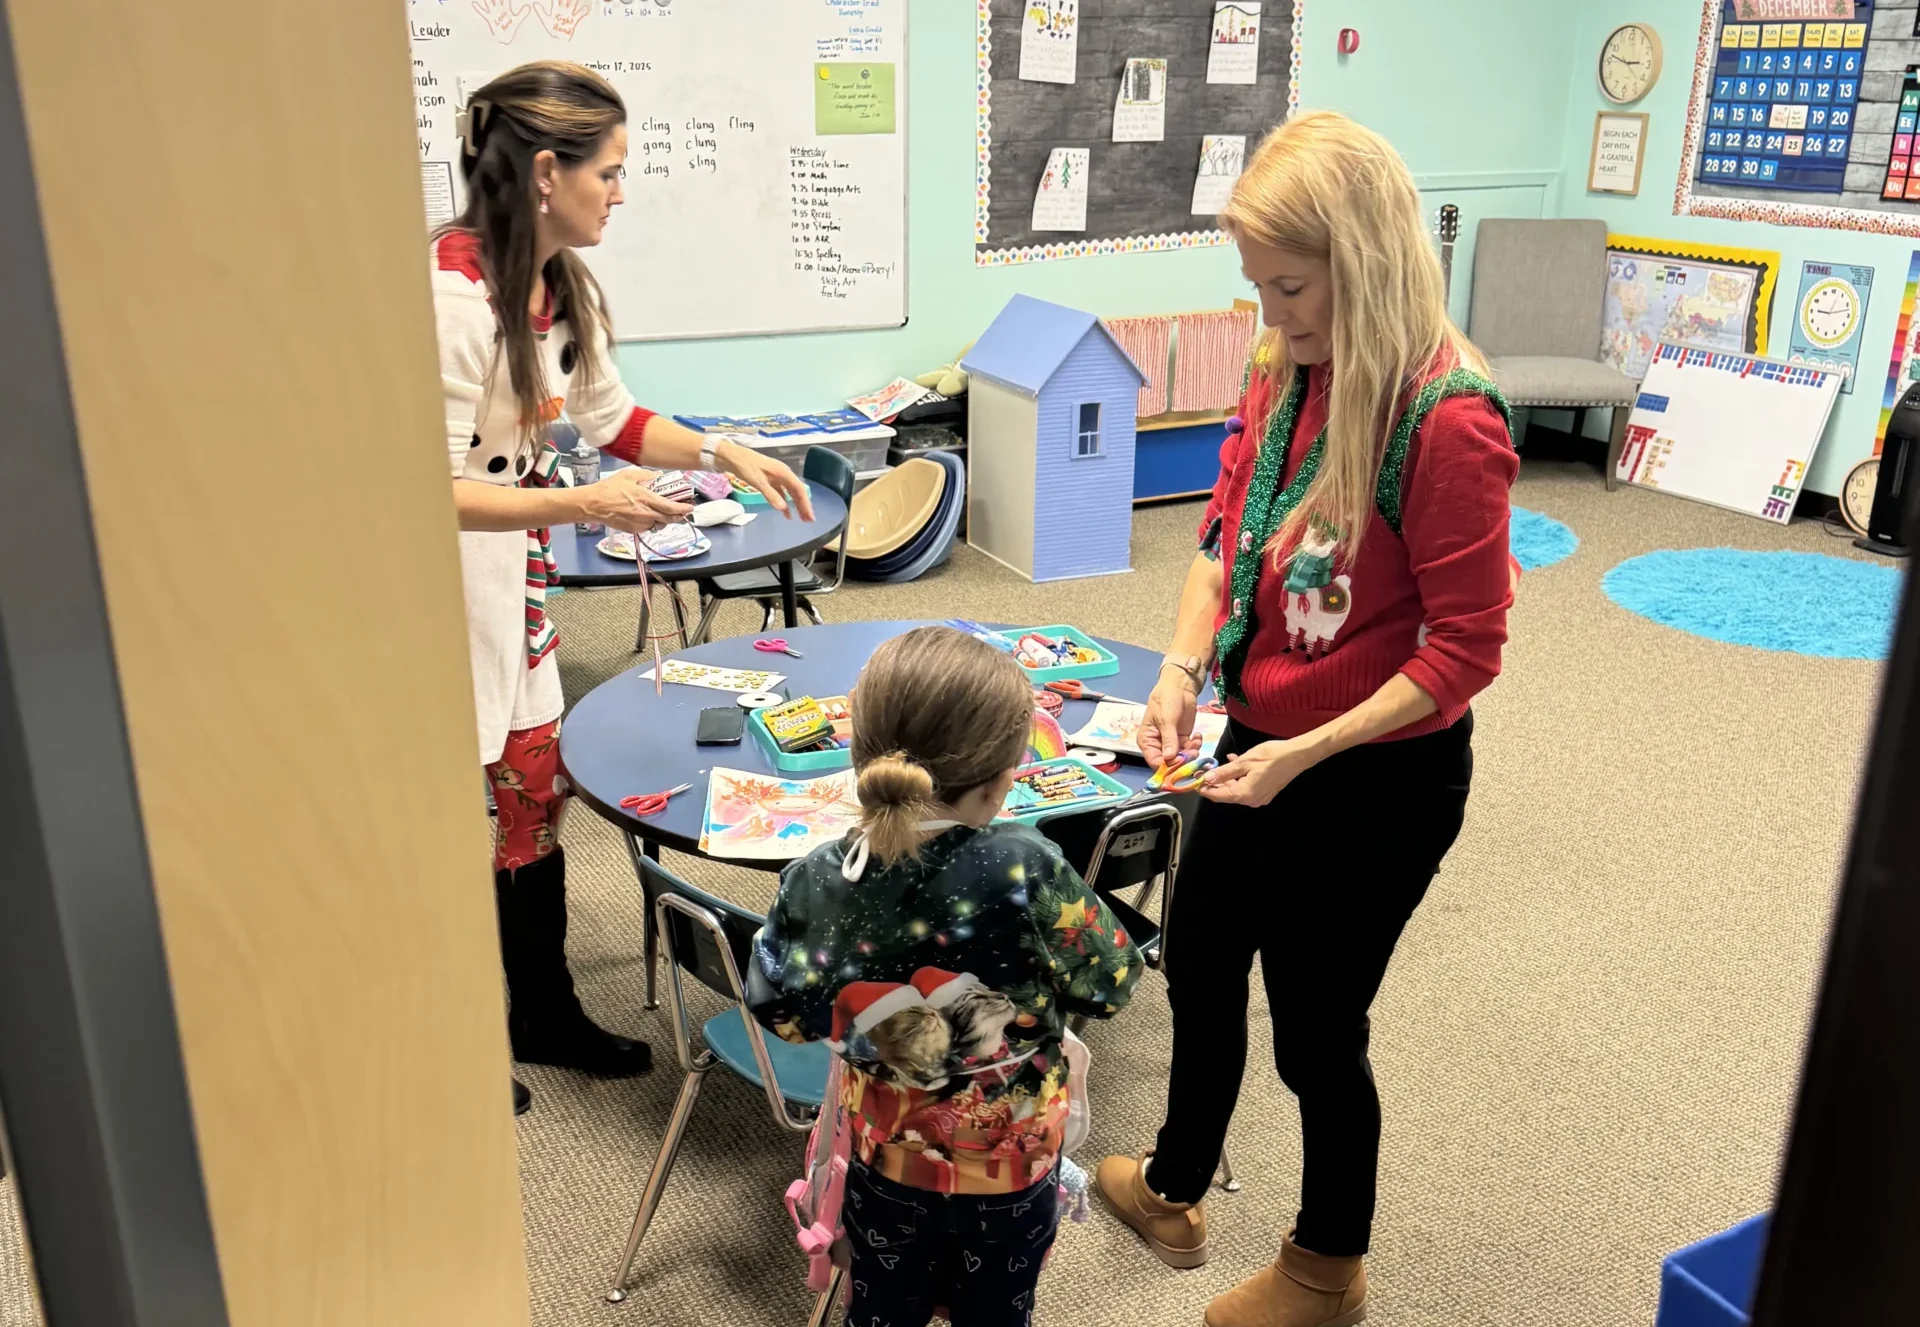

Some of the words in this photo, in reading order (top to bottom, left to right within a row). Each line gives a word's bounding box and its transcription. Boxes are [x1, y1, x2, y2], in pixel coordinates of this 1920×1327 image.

[1760, 0, 1828, 17] DECEMBER
[411, 20, 450, 38] Leader
[629, 62, 652, 71] 2025
[1745, 56, 1750, 69] 1
[1762, 56, 1771, 70] 2
[1782, 56, 1791, 69] 3
[1803, 55, 1812, 70] 4
[1824, 55, 1833, 69] 5
[1845, 57, 1854, 71] 6
[1720, 81, 1729, 95] 7
[1738, 82, 1747, 95] 8
[1758, 82, 1766, 96] 9
[1776, 82, 1789, 96] 10
[1799, 83, 1808, 97] 11
[1817, 83, 1830, 97] 12
[1840, 84, 1852, 98] 13
[1713, 107, 1724, 120] 14
[1732, 108, 1744, 121] 15
[1751, 108, 1763, 122] 16
[1812, 110, 1825, 124] 19
[1832, 111, 1848, 125] 20
[642, 117, 671, 135] cling
[686, 117, 715, 133] clang
[729, 116, 754, 132] fling
[686, 135, 716, 152] clung
[1709, 132, 1721, 146] 21
[1725, 133, 1740, 146] 22
[1746, 134, 1761, 148] 23
[1766, 136, 1782, 150] 24
[1788, 140, 1798, 150] 25
[1805, 138, 1821, 151] 26
[1828, 139, 1845, 153] 27
[790, 146, 827, 160] Wednesday
[644, 162, 670, 178] ding
[689, 154, 716, 173] sling
[811, 160, 829, 168] Circle
[833, 160, 849, 168] Time
[1705, 158, 1719, 172] 28
[1721, 159, 1736, 173] 29
[1742, 160, 1758, 174] 30
[1763, 164, 1773, 176] 31
[811, 182, 844, 197] Language
[845, 184, 861, 194] Arts
[811, 208, 831, 220] Recess
[816, 246, 842, 262] Spelling
[1806, 264, 1832, 276] TIME
[842, 277, 856, 286] Art
[1851, 492, 1858, 501] 9
